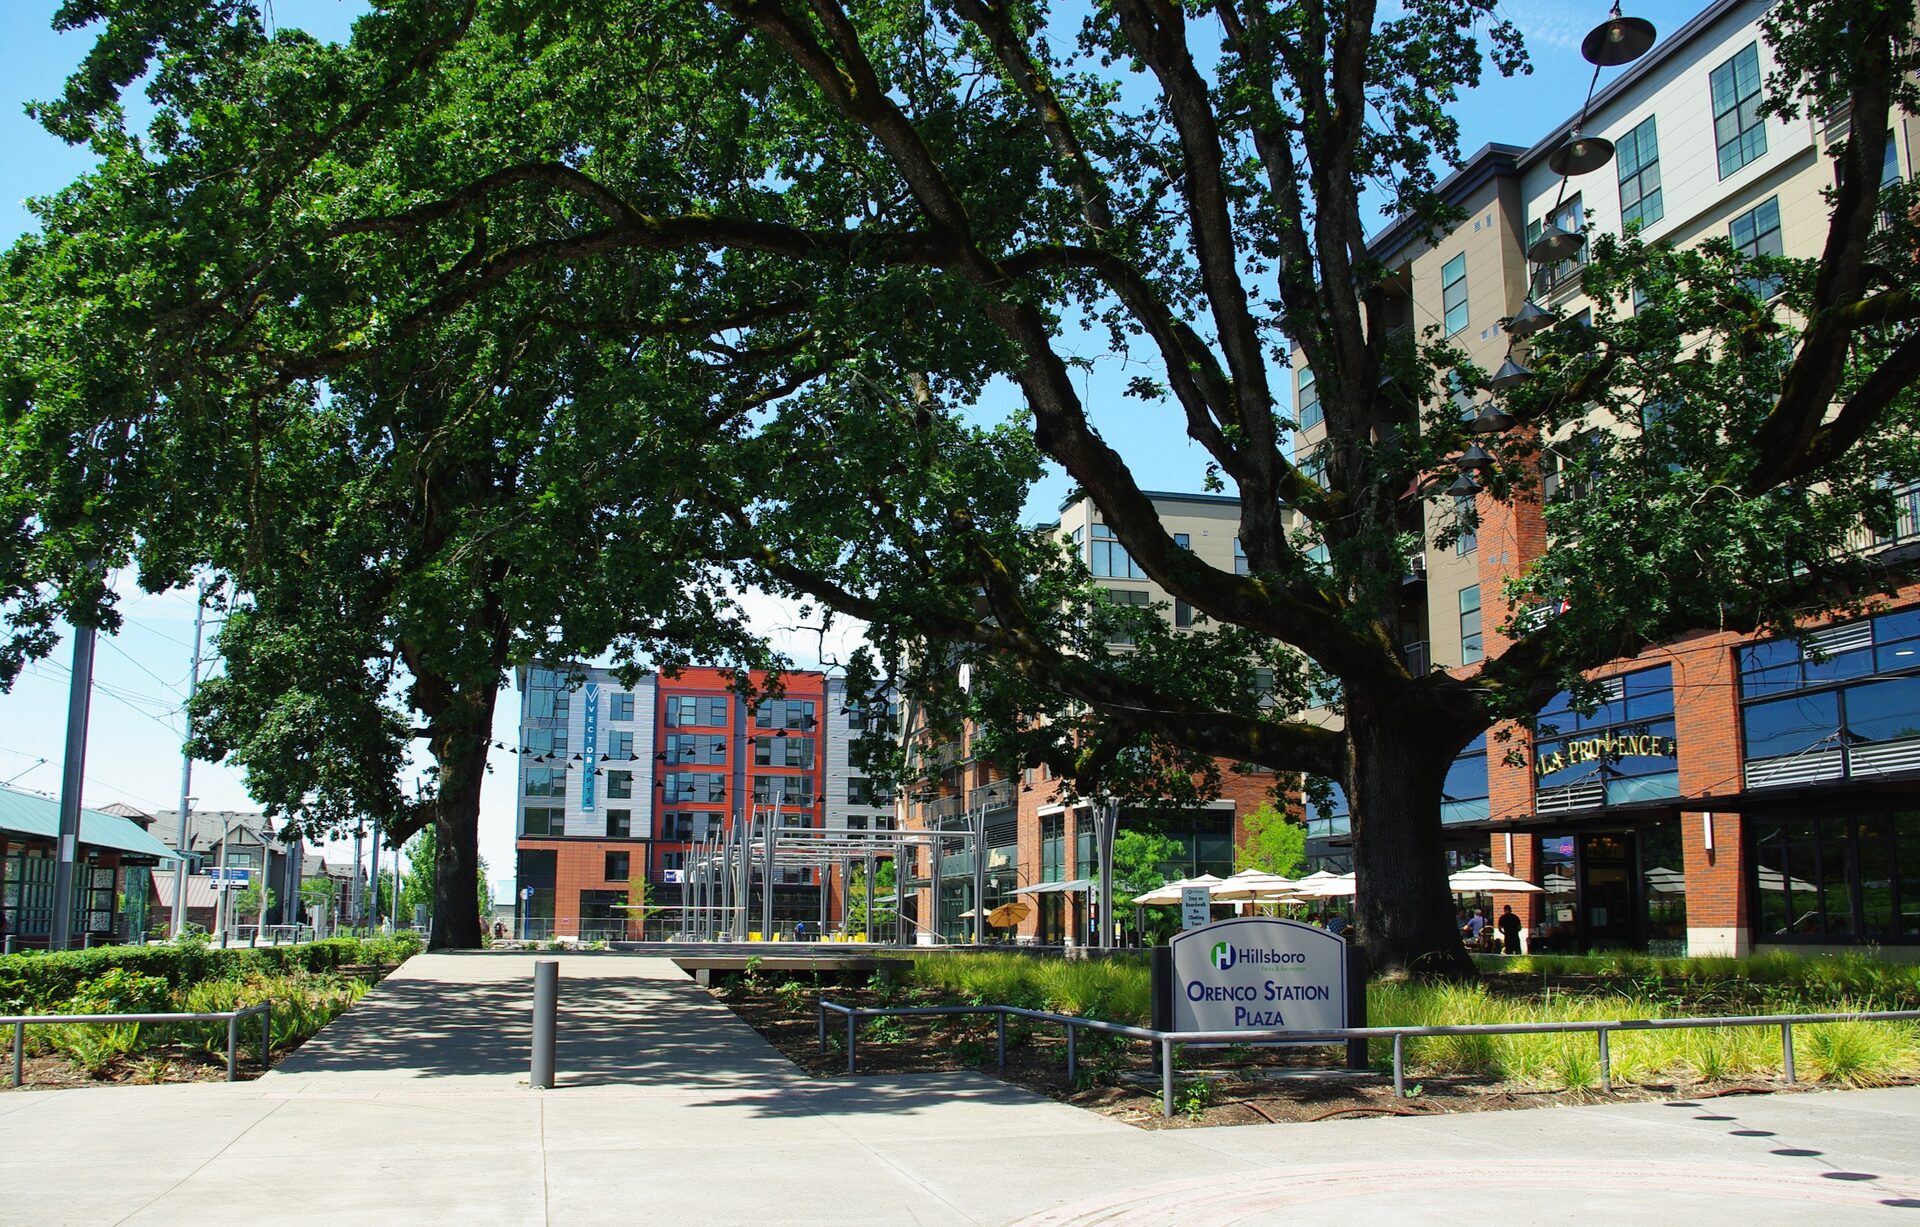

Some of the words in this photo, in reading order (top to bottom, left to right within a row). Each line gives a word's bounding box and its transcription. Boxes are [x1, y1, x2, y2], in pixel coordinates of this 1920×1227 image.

[586, 706, 595, 763] VECTOR
[1541, 752, 1565, 775] LA
[586, 767, 594, 804] APTS
[1239, 949, 1306, 964] Hillsboro
[1187, 981, 1257, 1002] ORENCO
[1264, 980, 1329, 1001] STATION
[1235, 1006, 1285, 1027] PLAZA
